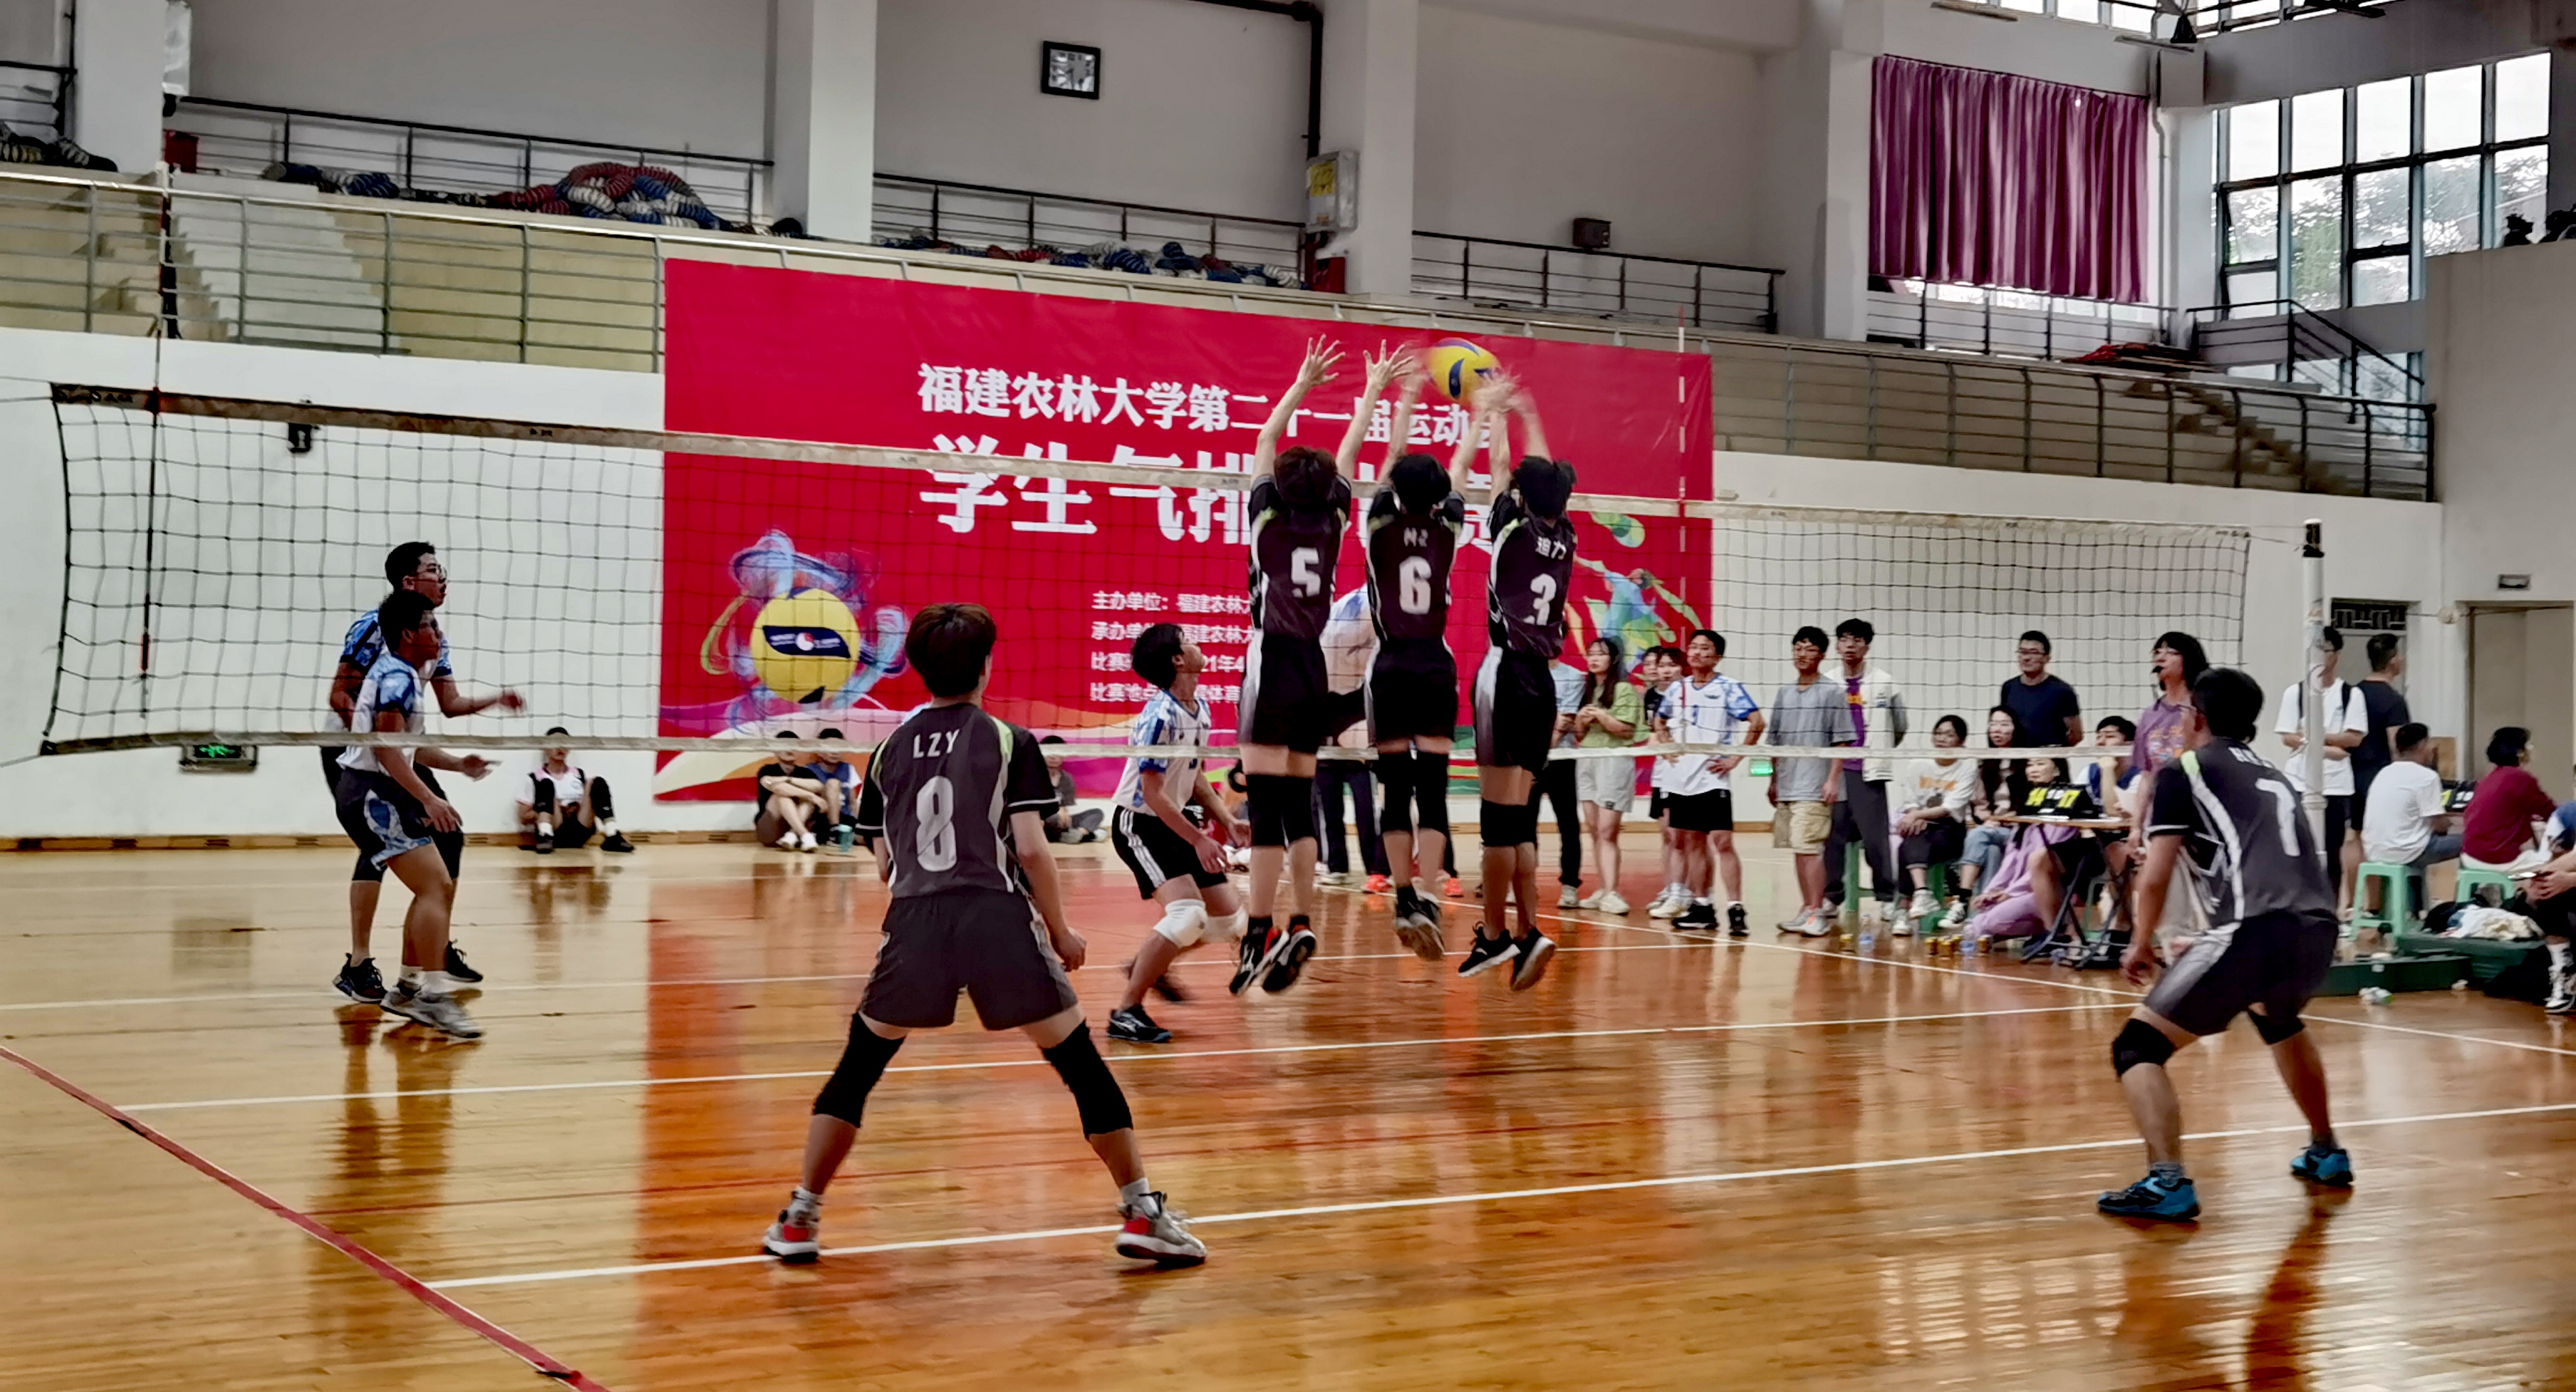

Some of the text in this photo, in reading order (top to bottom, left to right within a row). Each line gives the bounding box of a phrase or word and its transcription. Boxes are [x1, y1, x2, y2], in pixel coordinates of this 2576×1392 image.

[1290, 547, 1321, 598] 5
[1399, 557, 1432, 615] 6
[1523, 573, 1557, 626] 3
[913, 729, 960, 759] LZY
[916, 776, 957, 872] 8
[2256, 778, 2301, 857] 7
